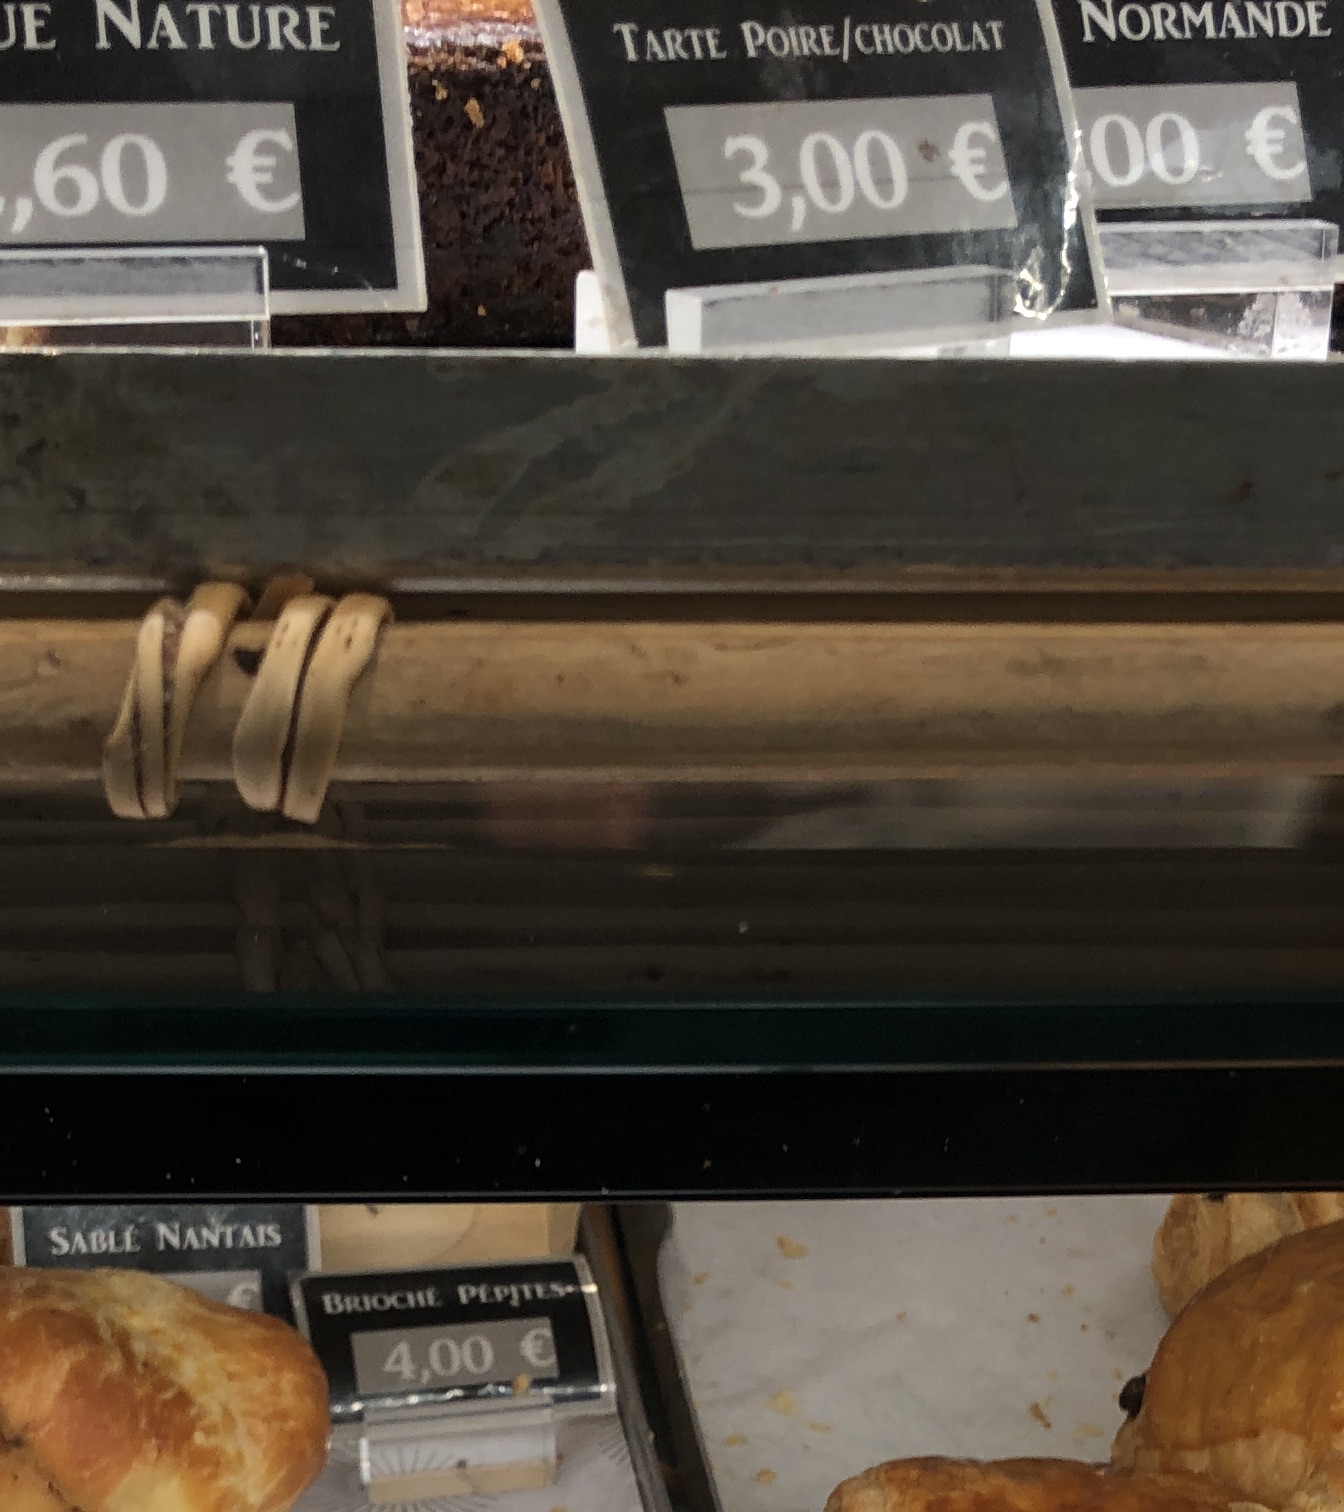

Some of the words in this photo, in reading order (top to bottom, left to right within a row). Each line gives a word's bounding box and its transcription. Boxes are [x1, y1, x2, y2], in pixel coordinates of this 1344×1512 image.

[95, 0, 342, 51] NATURE
[613, 21, 727, 62] TARTE
[740, 16, 1006, 63] POIRE/CHOCOLAT
[1077, 0, 1332, 43] NORMANDE
[1244, 105, 1306, 181] €
[226, 127, 302, 213] €
[723, 129, 909, 232] 3,00
[947, 120, 1008, 202] €
[156, 1221, 283, 1251] NANTAIS
[321, 1287, 445, 1315] BRIOCHE
[382, 1334, 495, 1386] 4,00
[519, 1326, 556, 1368] €
